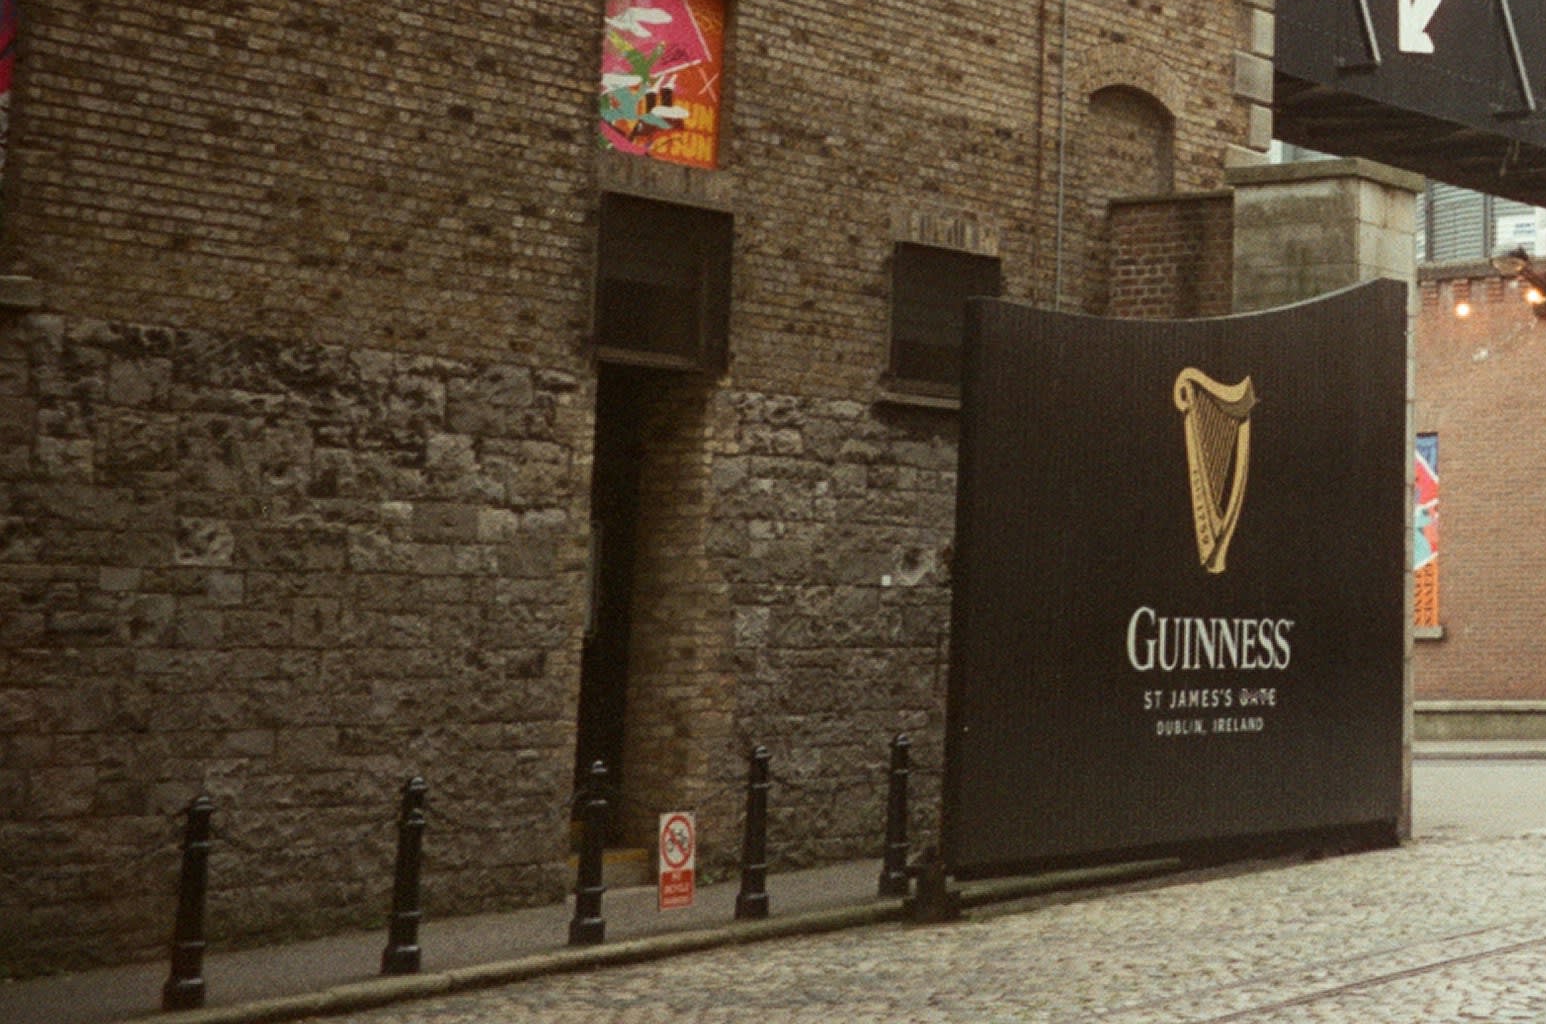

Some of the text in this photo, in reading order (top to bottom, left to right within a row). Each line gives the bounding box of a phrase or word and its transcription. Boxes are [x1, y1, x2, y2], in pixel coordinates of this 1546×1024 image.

[1127, 606, 1295, 671] GUINNESS
[1144, 688, 1277, 710] ST JAMES'S GATE
[1212, 717, 1264, 733] IRELAND
